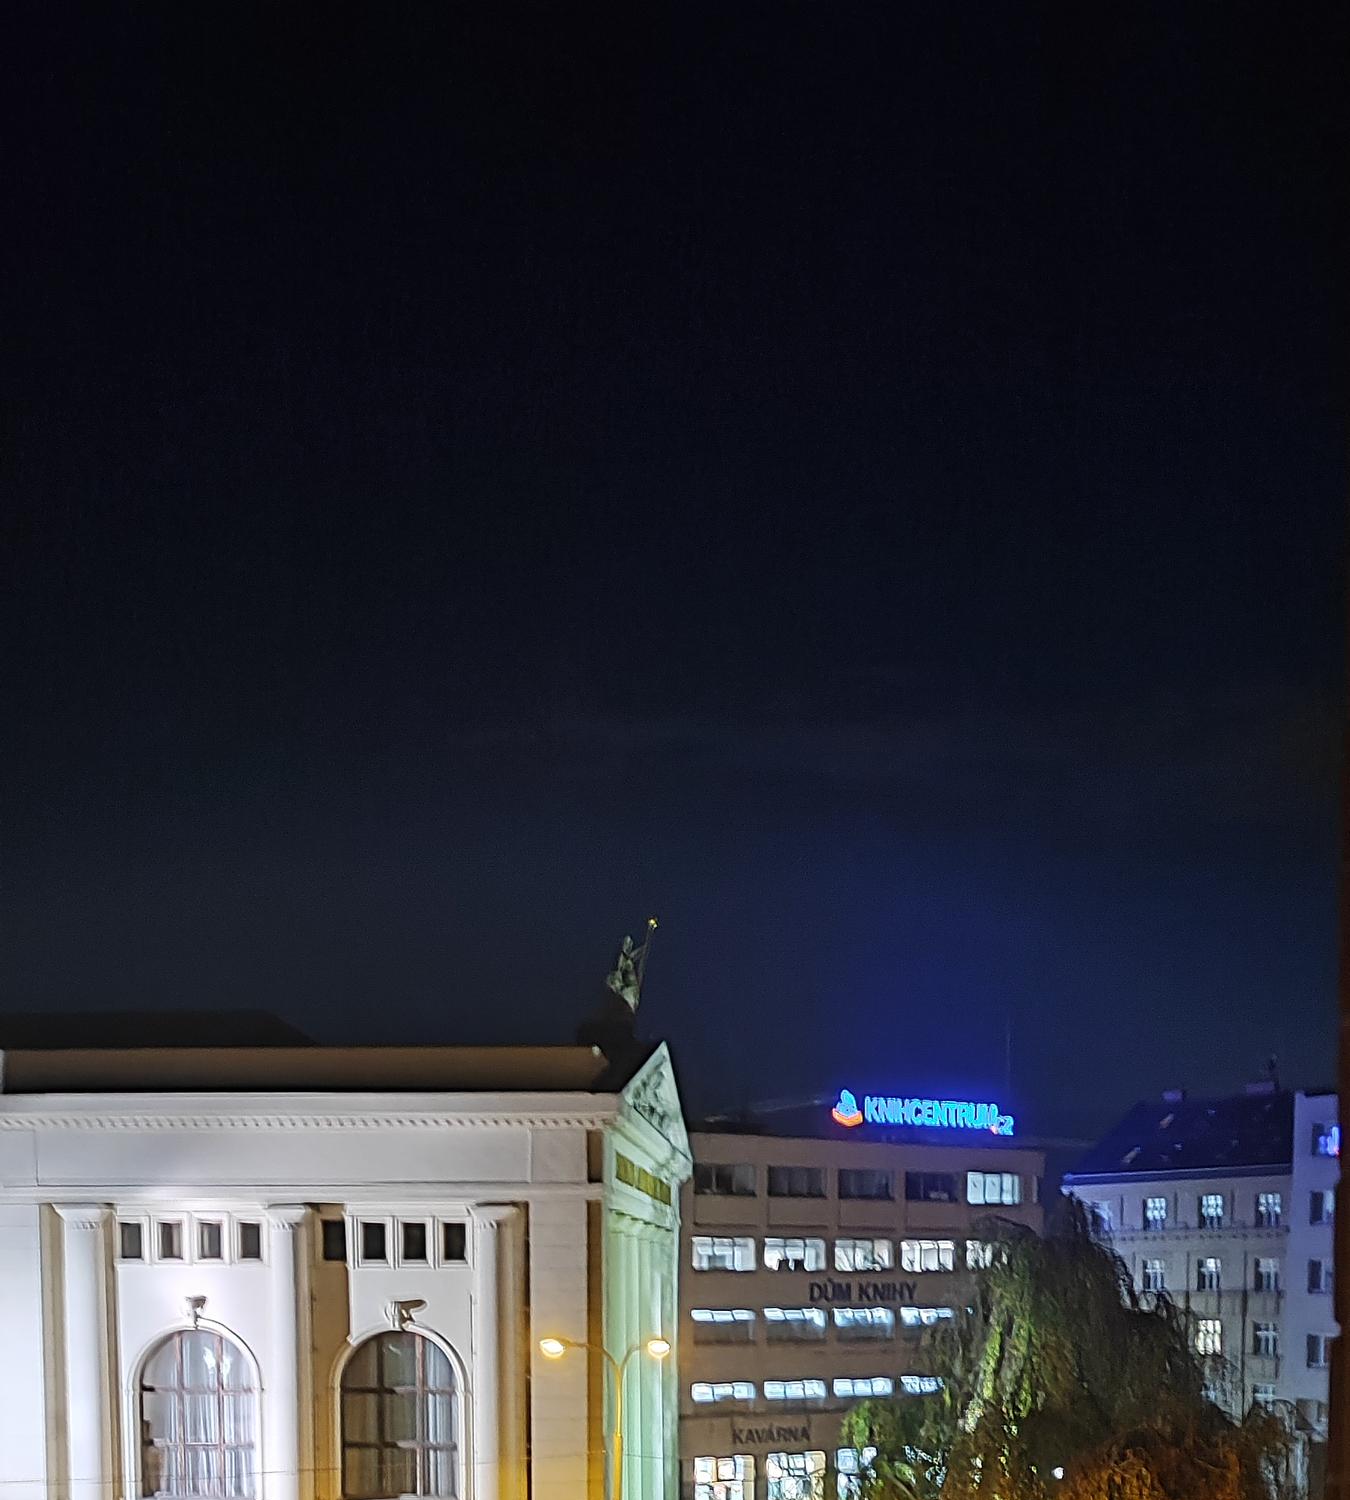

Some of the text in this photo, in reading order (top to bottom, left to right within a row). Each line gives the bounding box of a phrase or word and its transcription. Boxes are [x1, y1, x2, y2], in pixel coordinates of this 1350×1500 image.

[809, 1277, 918, 1302] DŮM KNIHY
[732, 1423, 810, 1444] KAVÁRNA
